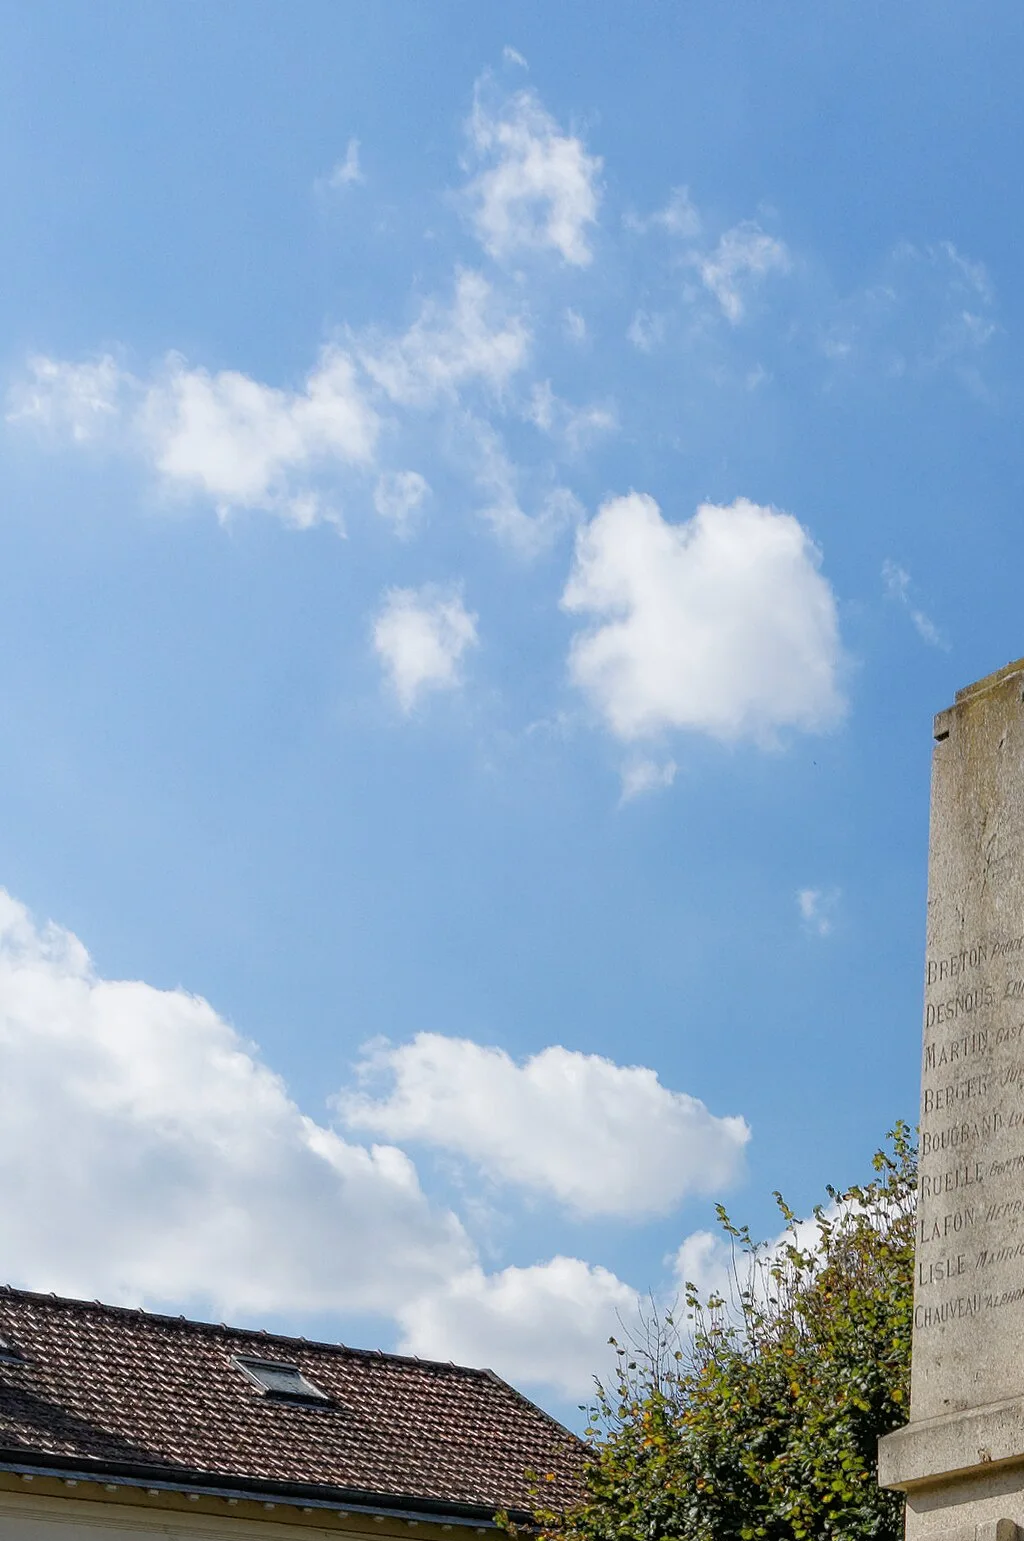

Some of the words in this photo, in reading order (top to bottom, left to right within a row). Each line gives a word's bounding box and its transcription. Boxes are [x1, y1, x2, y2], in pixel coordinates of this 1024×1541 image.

[927, 945, 987, 986] BRETON
[926, 985, 994, 1028] DESNOUS
[924, 1030, 988, 1072] MARTIN
[919, 1208, 974, 1244] LAFON
[918, 1254, 966, 1286] LISLE
[914, 1292, 981, 1330] CHAUVEAU
